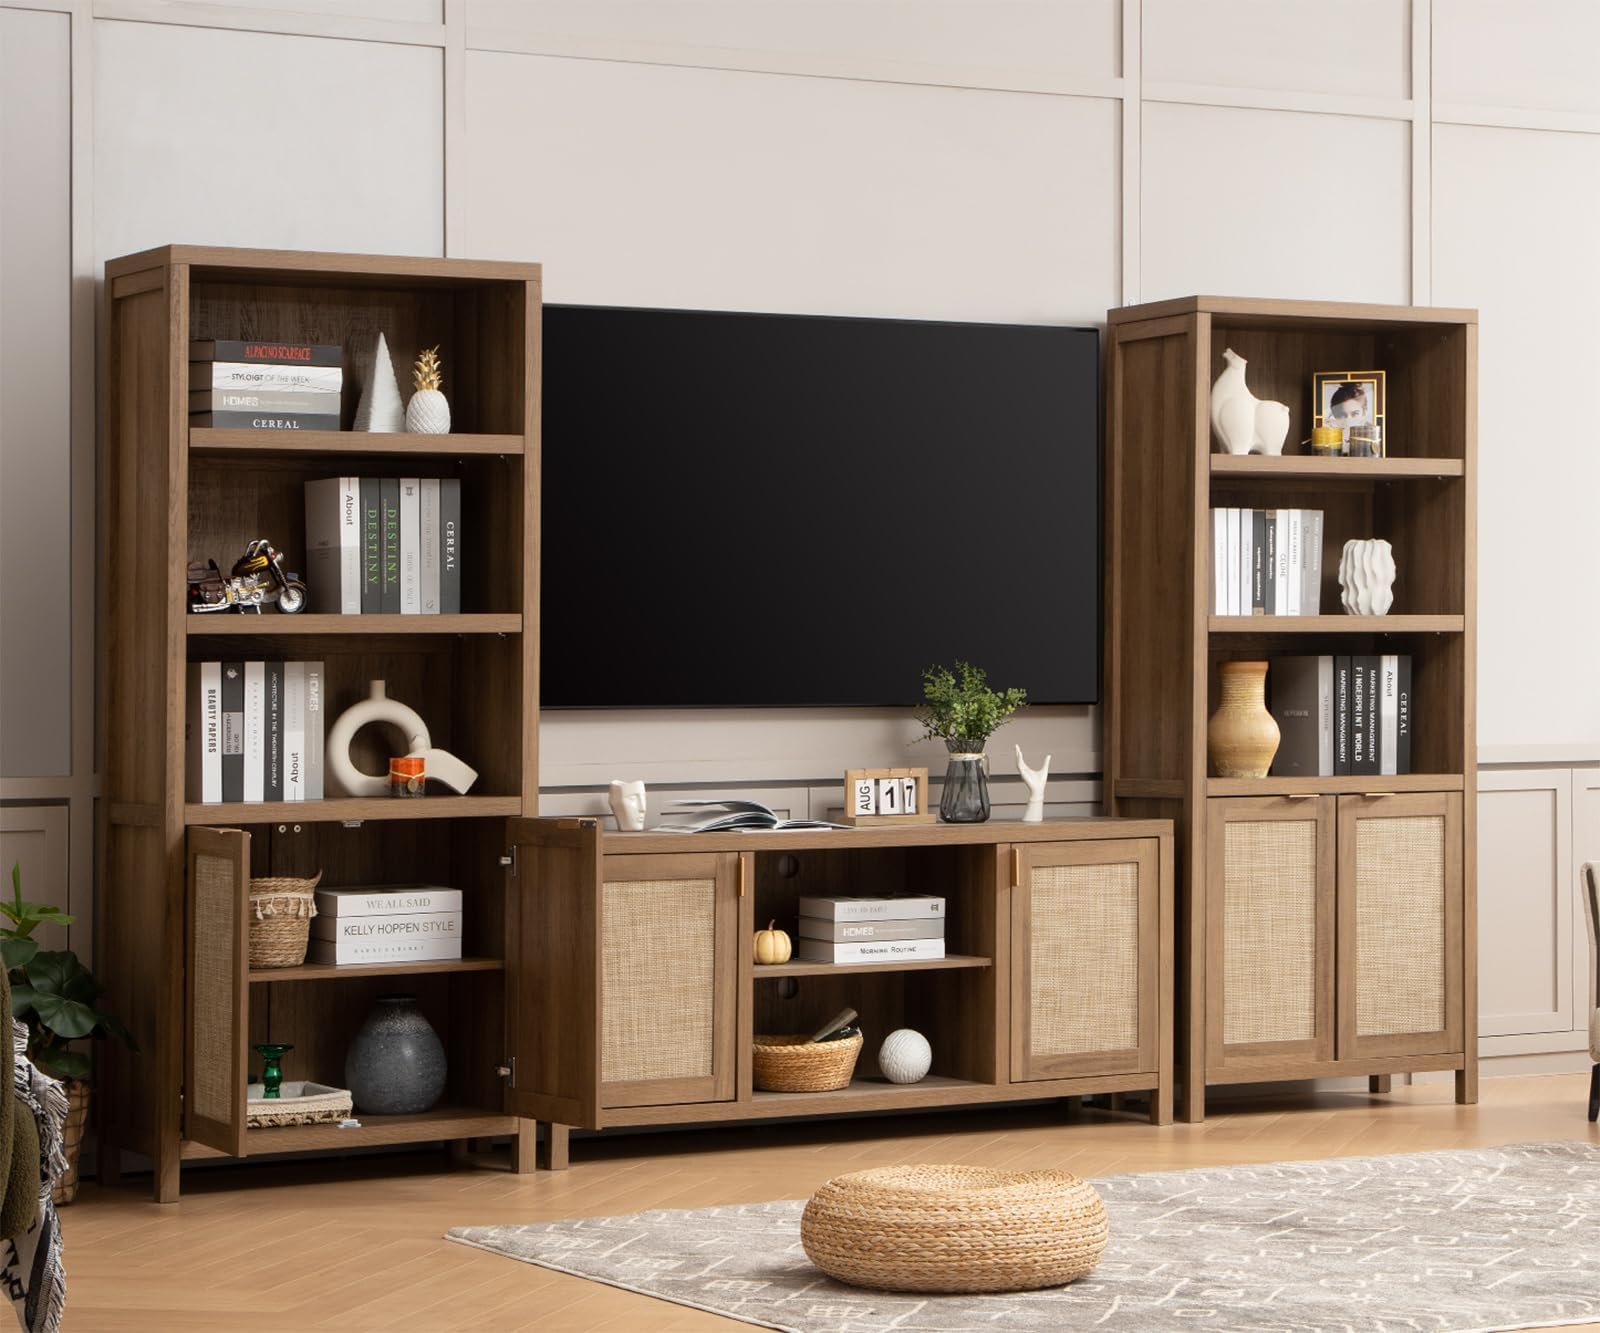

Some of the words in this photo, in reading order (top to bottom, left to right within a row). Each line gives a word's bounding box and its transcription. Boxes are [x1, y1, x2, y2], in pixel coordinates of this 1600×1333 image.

[265, 374, 276, 382] OF
[277, 375, 289, 383] THE
[290, 375, 310, 384] WEEK
[223, 396, 259, 407] HOMES
[252, 418, 300, 429] CEREAL
[345, 495, 355, 526] About
[367, 509, 377, 585] DESTINY
[387, 508, 397, 585] DESTINY
[446, 521, 455, 572] CEREAL
[207, 689, 216, 720] BEAUTY
[1355, 667, 1363, 728] FINGERPRINT
[1400, 692, 1408, 736] CEREAL
[207, 722, 216, 753] PAPERS
[1354, 732, 1362, 762] WORLD
[290, 752, 299, 784] About
[859, 785, 871, 811] AUG
[344, 924, 377, 936] KELLY
[377, 923, 420, 934] HOPPEN
[422, 920, 455, 932] STYLE
[842, 927, 874, 937] HOMES
